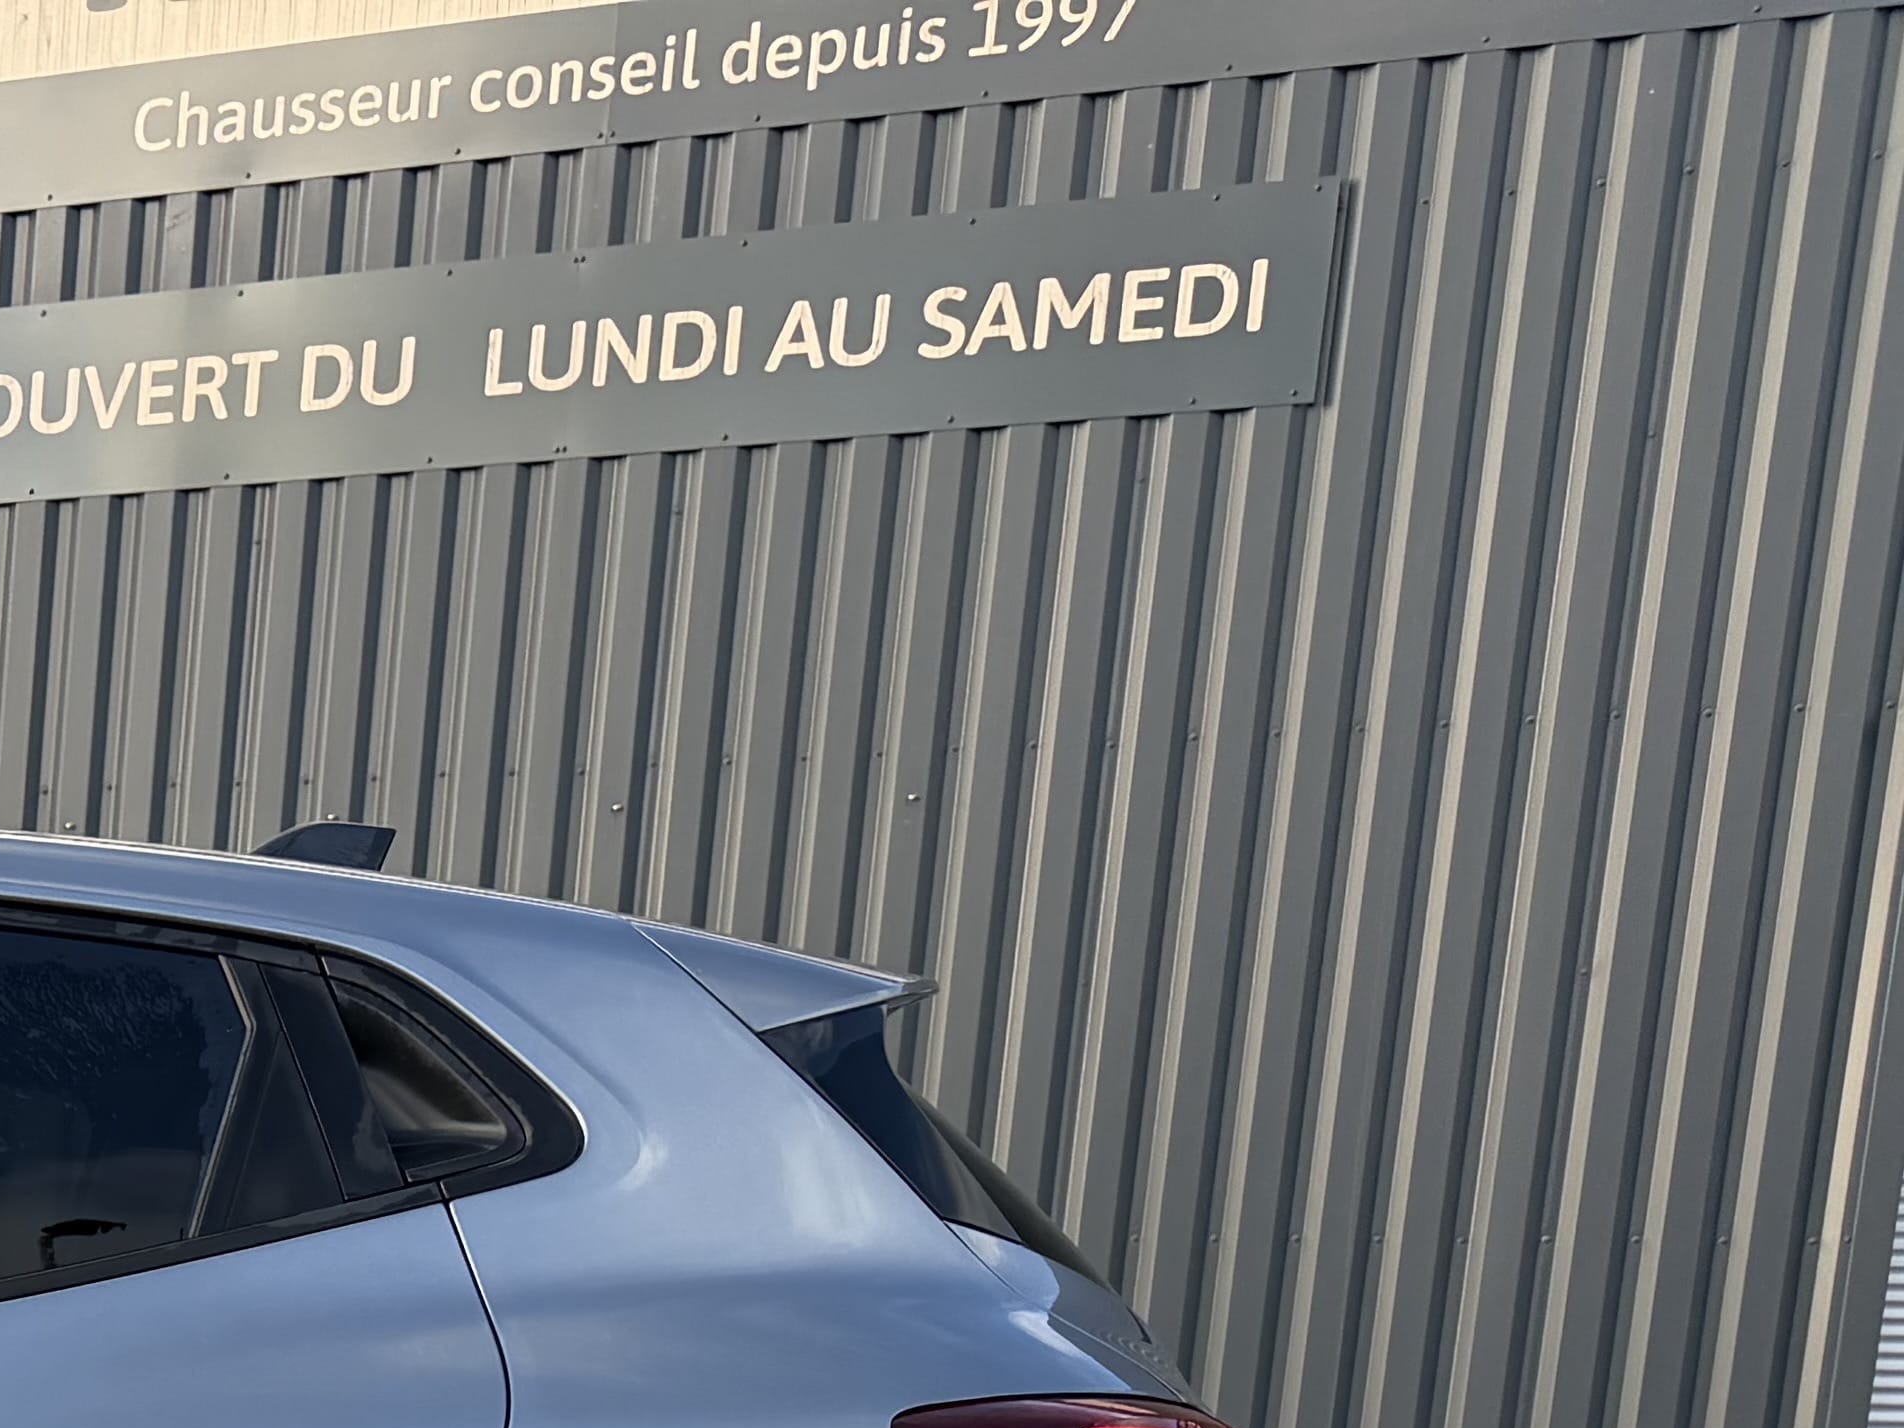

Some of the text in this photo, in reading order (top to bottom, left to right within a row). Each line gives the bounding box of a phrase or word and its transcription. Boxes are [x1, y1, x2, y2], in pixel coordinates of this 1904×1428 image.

[134, 0, 1137, 152] Chausseur conseil depuis 1997
[298, 334, 417, 414] DU
[483, 304, 743, 397] LUNDI
[764, 292, 893, 376] AU
[916, 256, 1269, 359] SAMEDI
